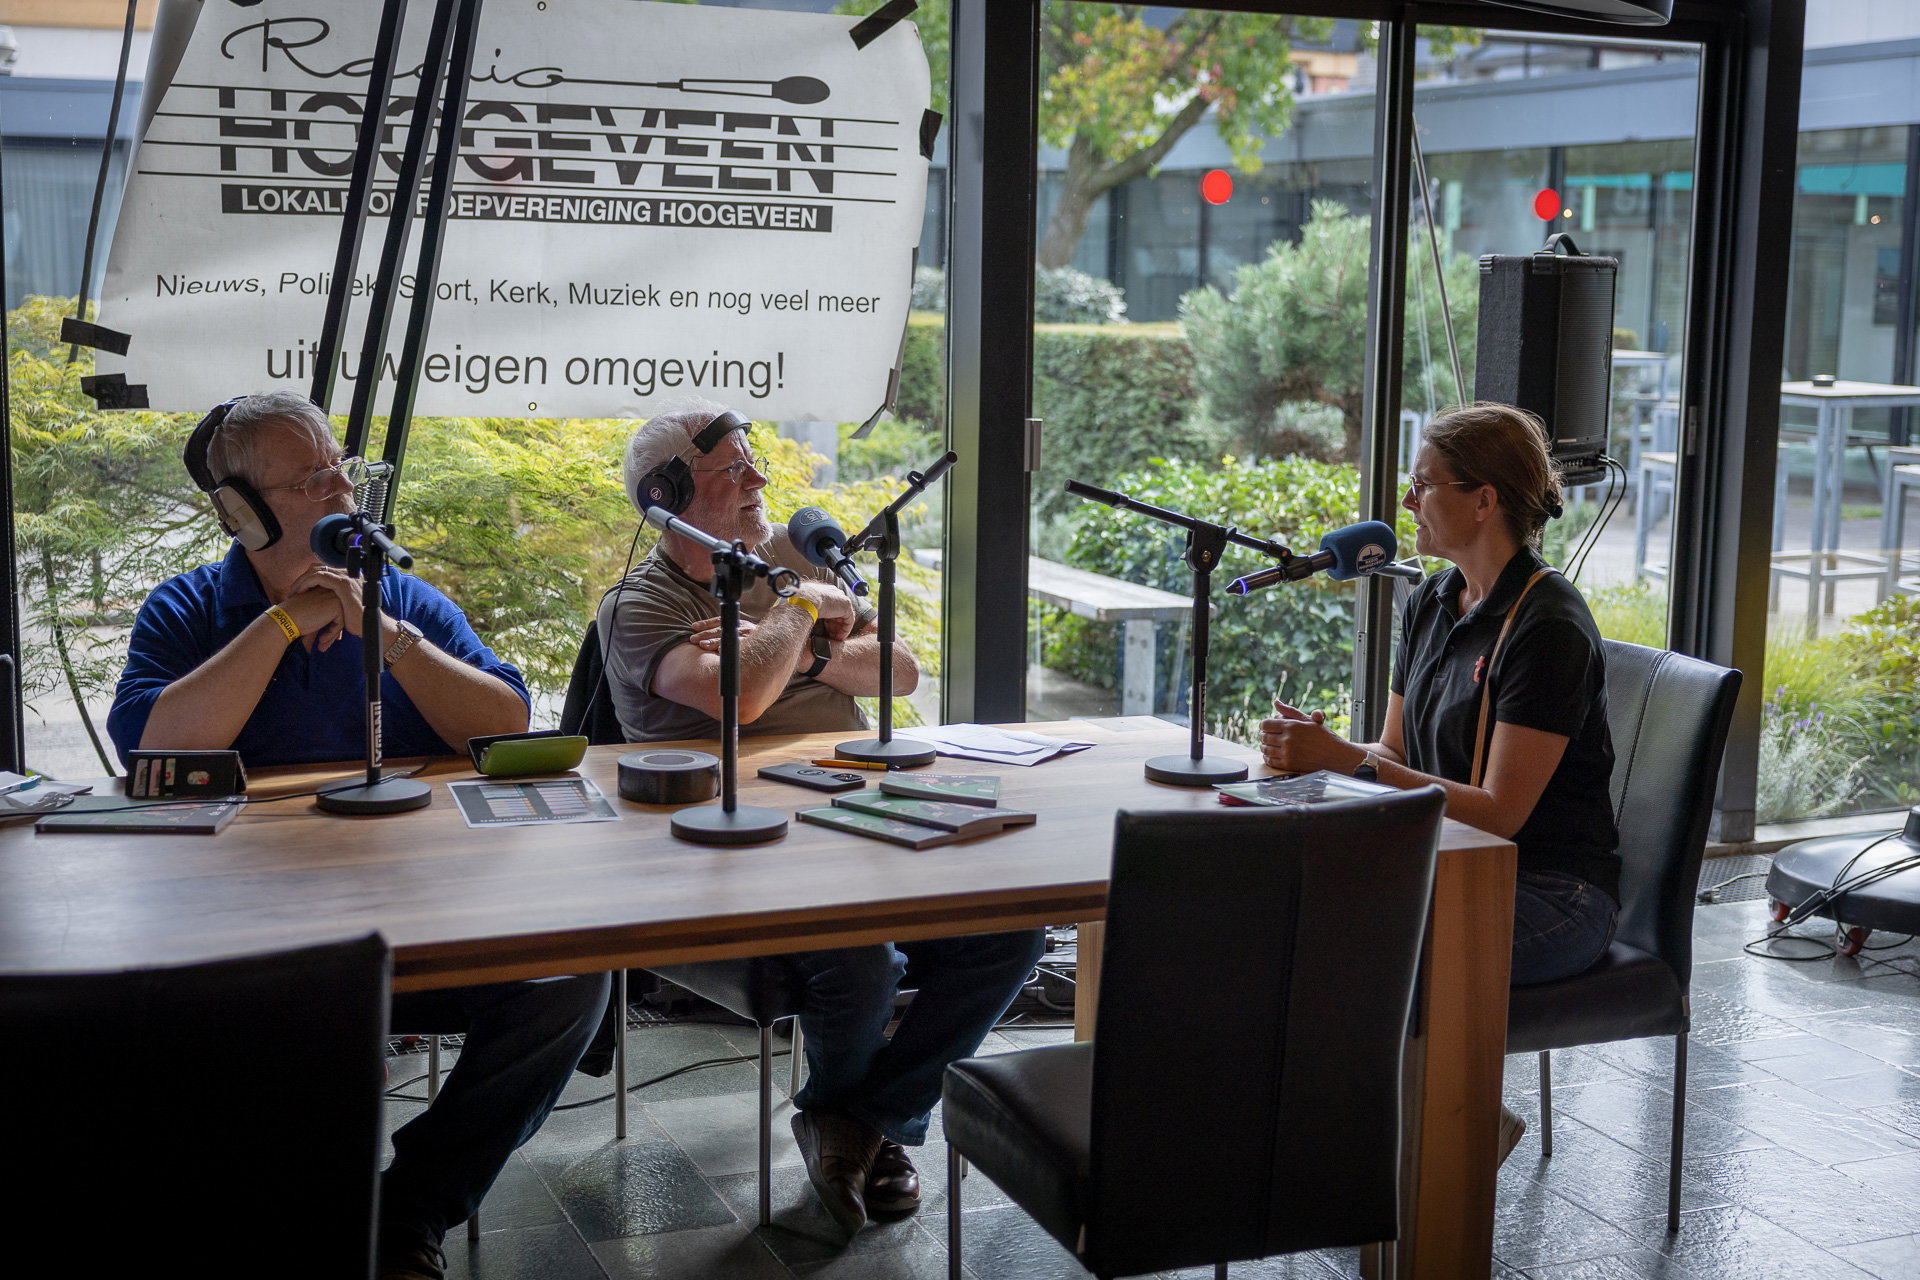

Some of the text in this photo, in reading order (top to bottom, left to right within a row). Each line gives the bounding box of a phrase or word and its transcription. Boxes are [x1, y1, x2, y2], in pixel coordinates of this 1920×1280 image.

[221, 17, 564, 88] Raio
[219, 86, 834, 194] HOOGEVEEN
[658, 203, 818, 229] HOOGEVEEN
[156, 272, 880, 315] Nieuws, Poliek Sort, Kerk, Muziek en nog veel meer
[423, 344, 548, 394] eigen
[564, 350, 786, 398] omgeving!
